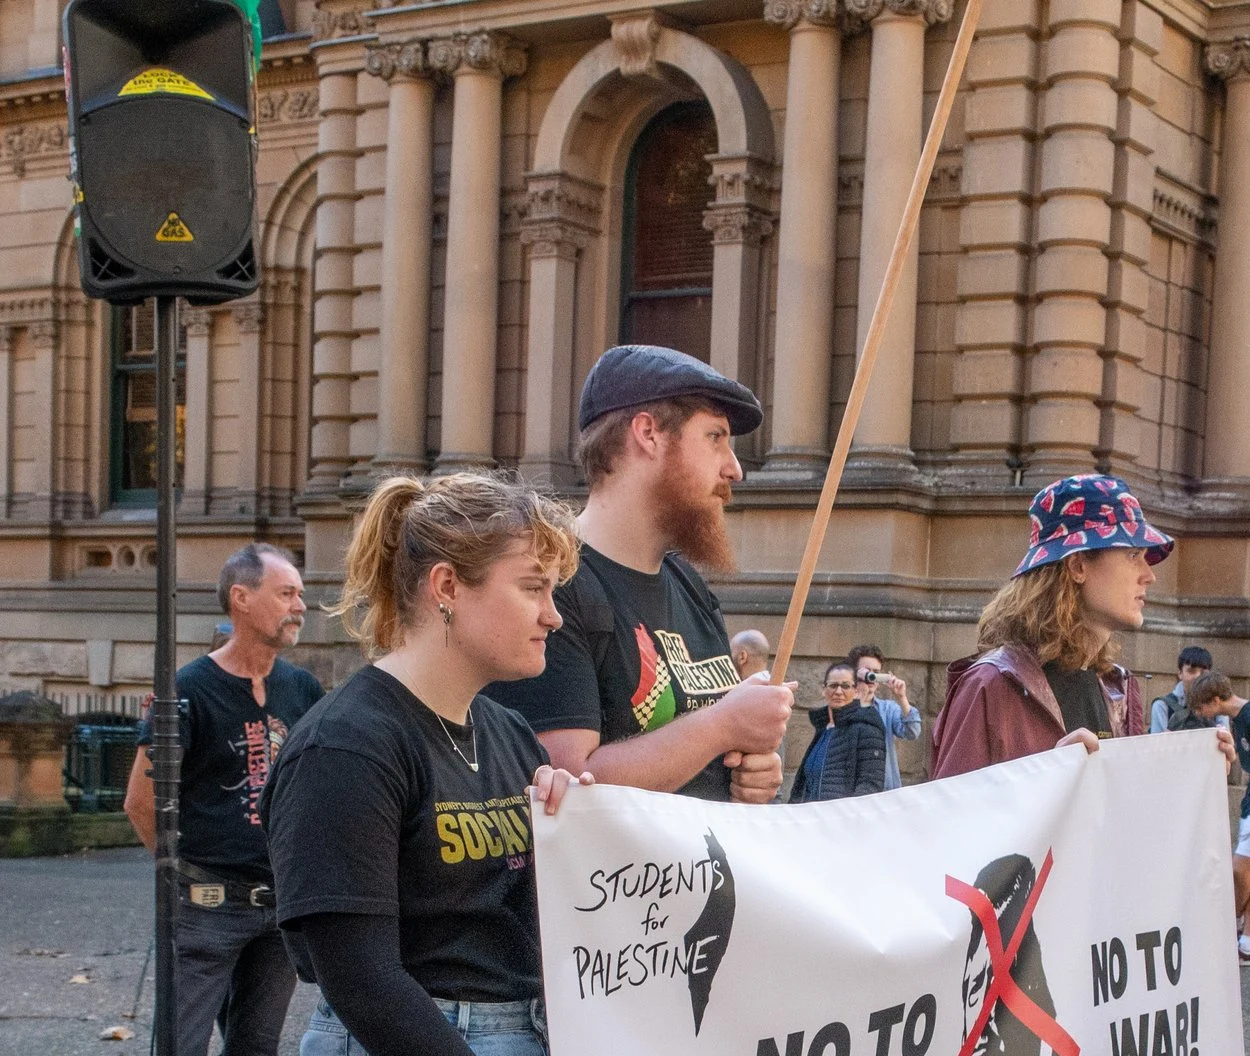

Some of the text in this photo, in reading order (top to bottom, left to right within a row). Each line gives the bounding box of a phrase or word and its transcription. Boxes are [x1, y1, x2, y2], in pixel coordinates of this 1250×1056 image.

[157, 76, 192, 85] GATE
[660, 632, 690, 664] FREE
[671, 657, 742, 692] PALESTINE
[574, 857, 725, 912] STUDENTS
[641, 902, 670, 935] for
[572, 934, 720, 1000] PALESTINE
[1090, 926, 1183, 1007] NO TO
